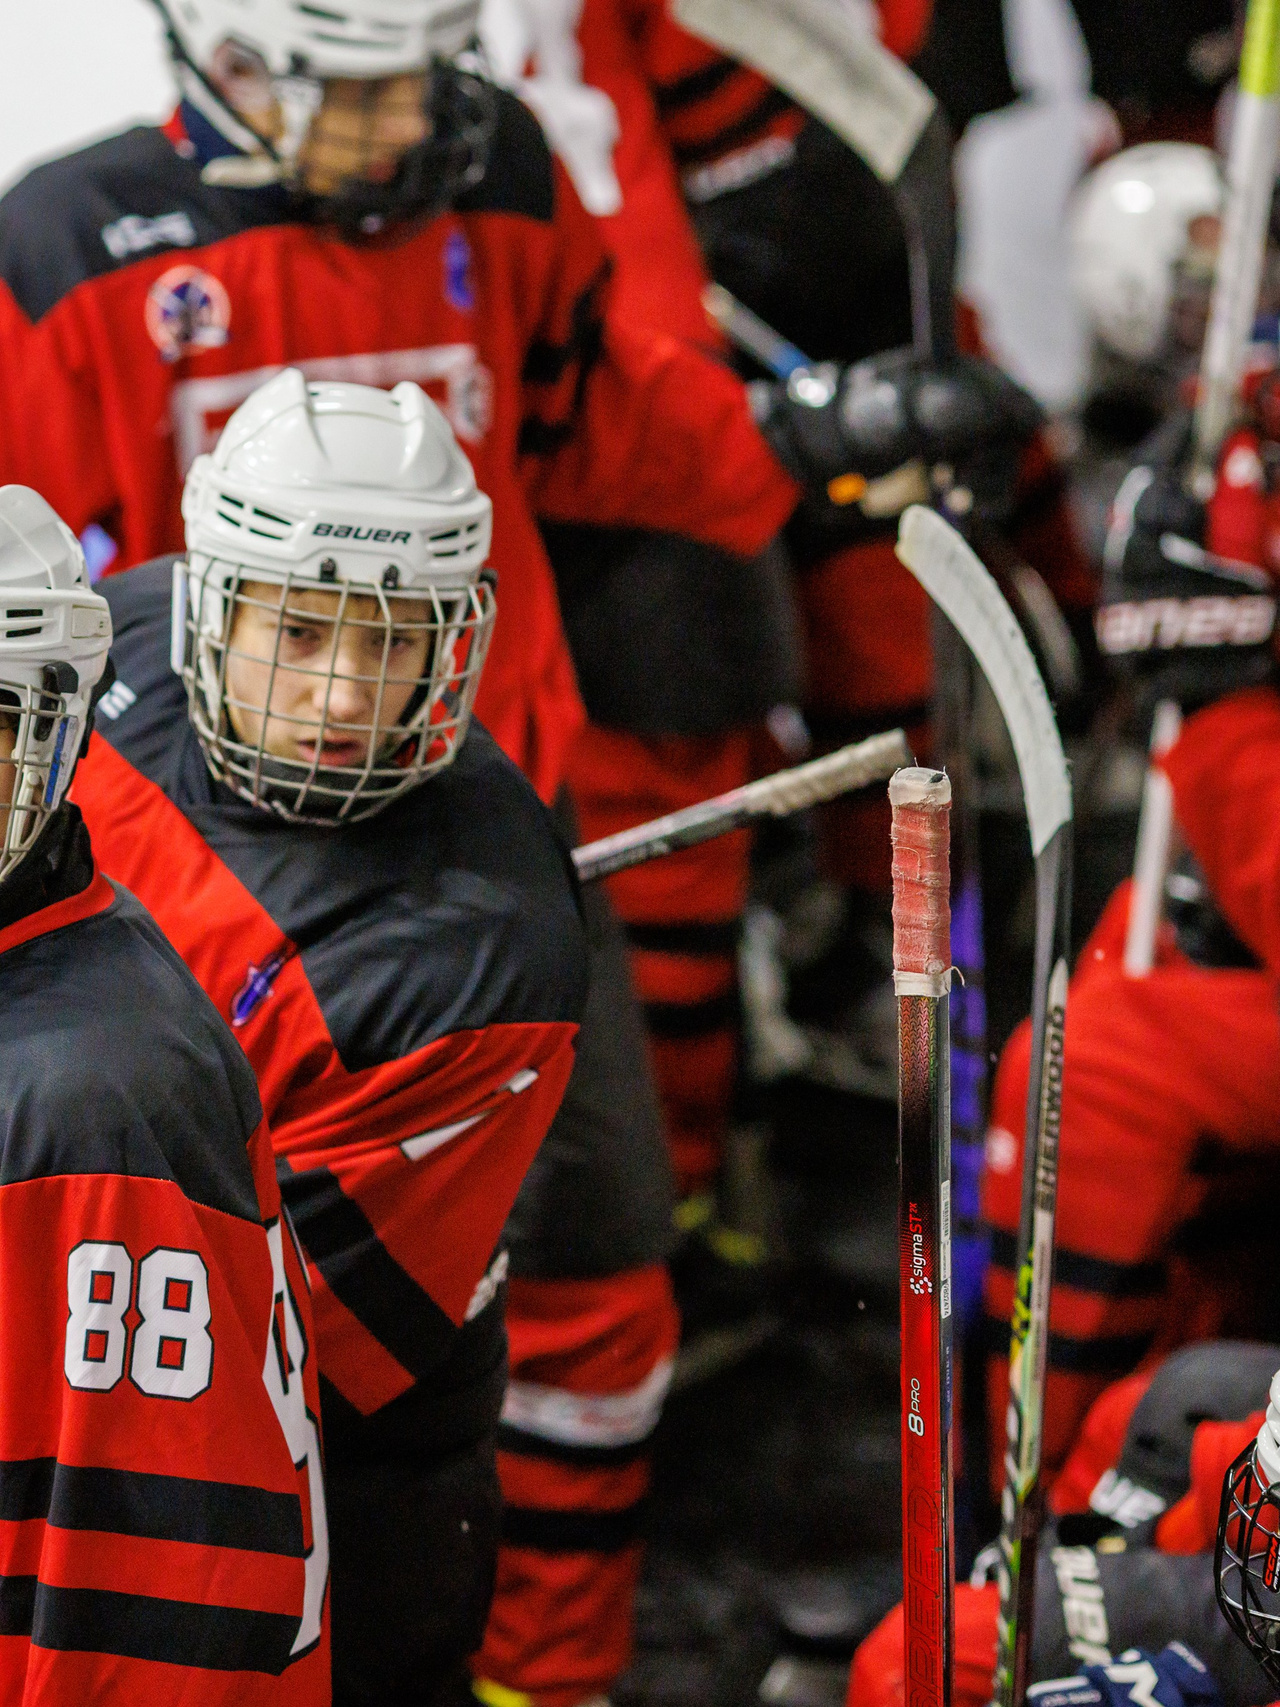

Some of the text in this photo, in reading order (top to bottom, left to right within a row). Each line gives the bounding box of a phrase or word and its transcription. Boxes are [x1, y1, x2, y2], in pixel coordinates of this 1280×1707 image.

[312, 523, 411, 545] BAUER
[63, 1238, 215, 1403] 88
[908, 1378, 924, 1437] 8 PRO
